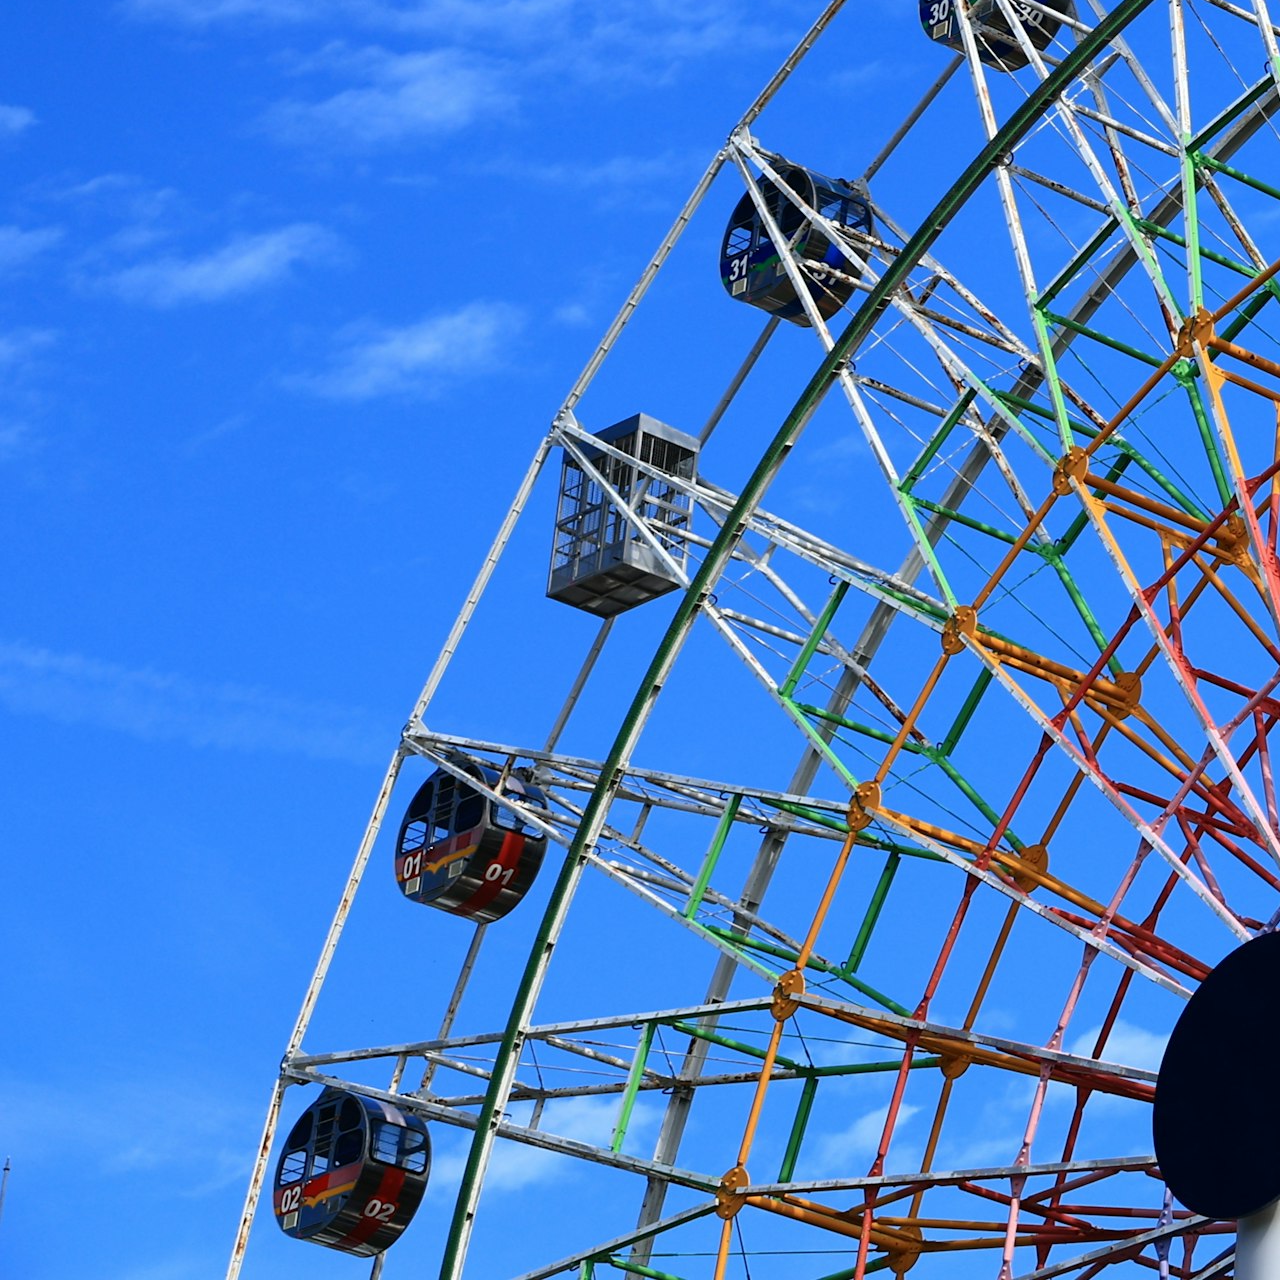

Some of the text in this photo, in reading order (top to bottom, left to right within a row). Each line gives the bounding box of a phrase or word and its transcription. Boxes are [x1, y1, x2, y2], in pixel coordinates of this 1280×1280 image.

[929, 0, 948, 25] 30
[729, 258, 748, 280] 31
[403, 853, 422, 879] 01
[485, 863, 513, 886] 01
[281, 1185, 300, 1212] 02
[364, 1199, 396, 1223] 02
